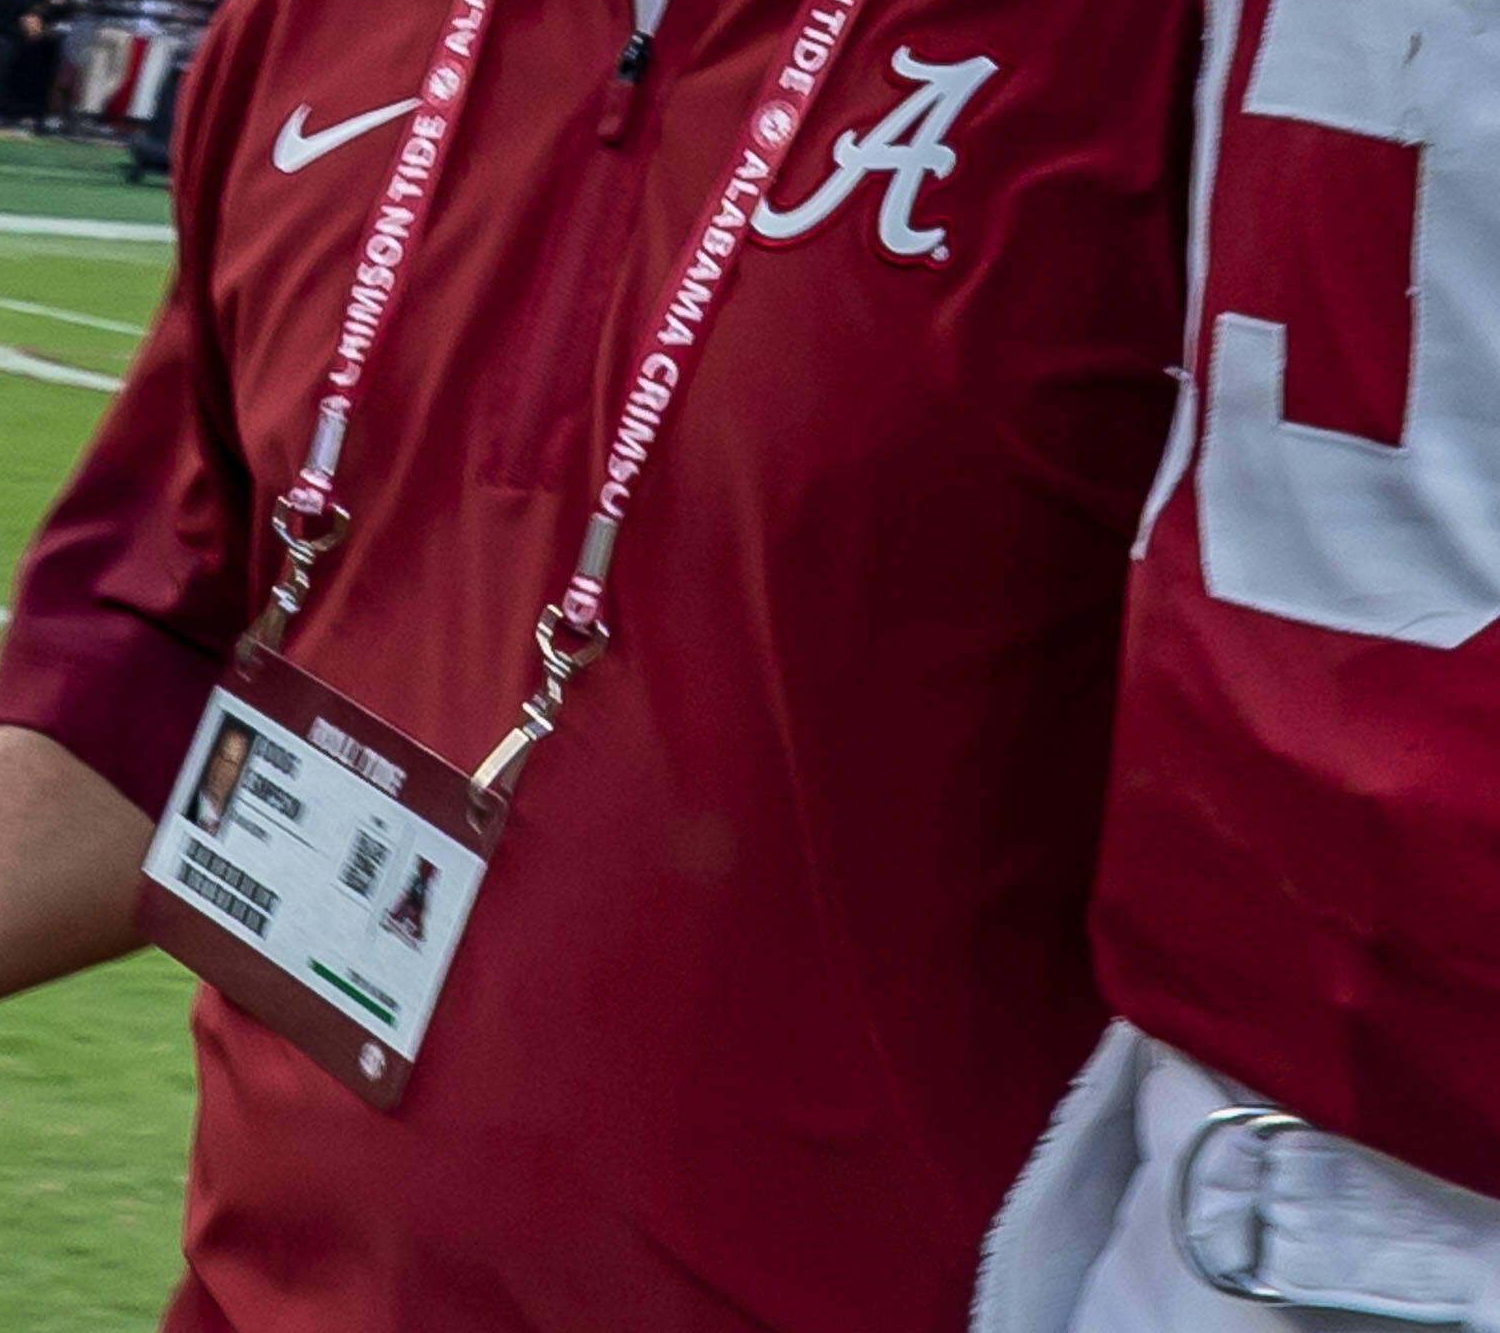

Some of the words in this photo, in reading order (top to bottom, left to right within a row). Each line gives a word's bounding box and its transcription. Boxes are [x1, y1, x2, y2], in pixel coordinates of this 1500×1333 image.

[779, 9, 846, 97] TIDE
[386, 115, 448, 202] TIDE
[657, 148, 769, 346] ALABAMA
[601, 353, 680, 520] CRIMSO
